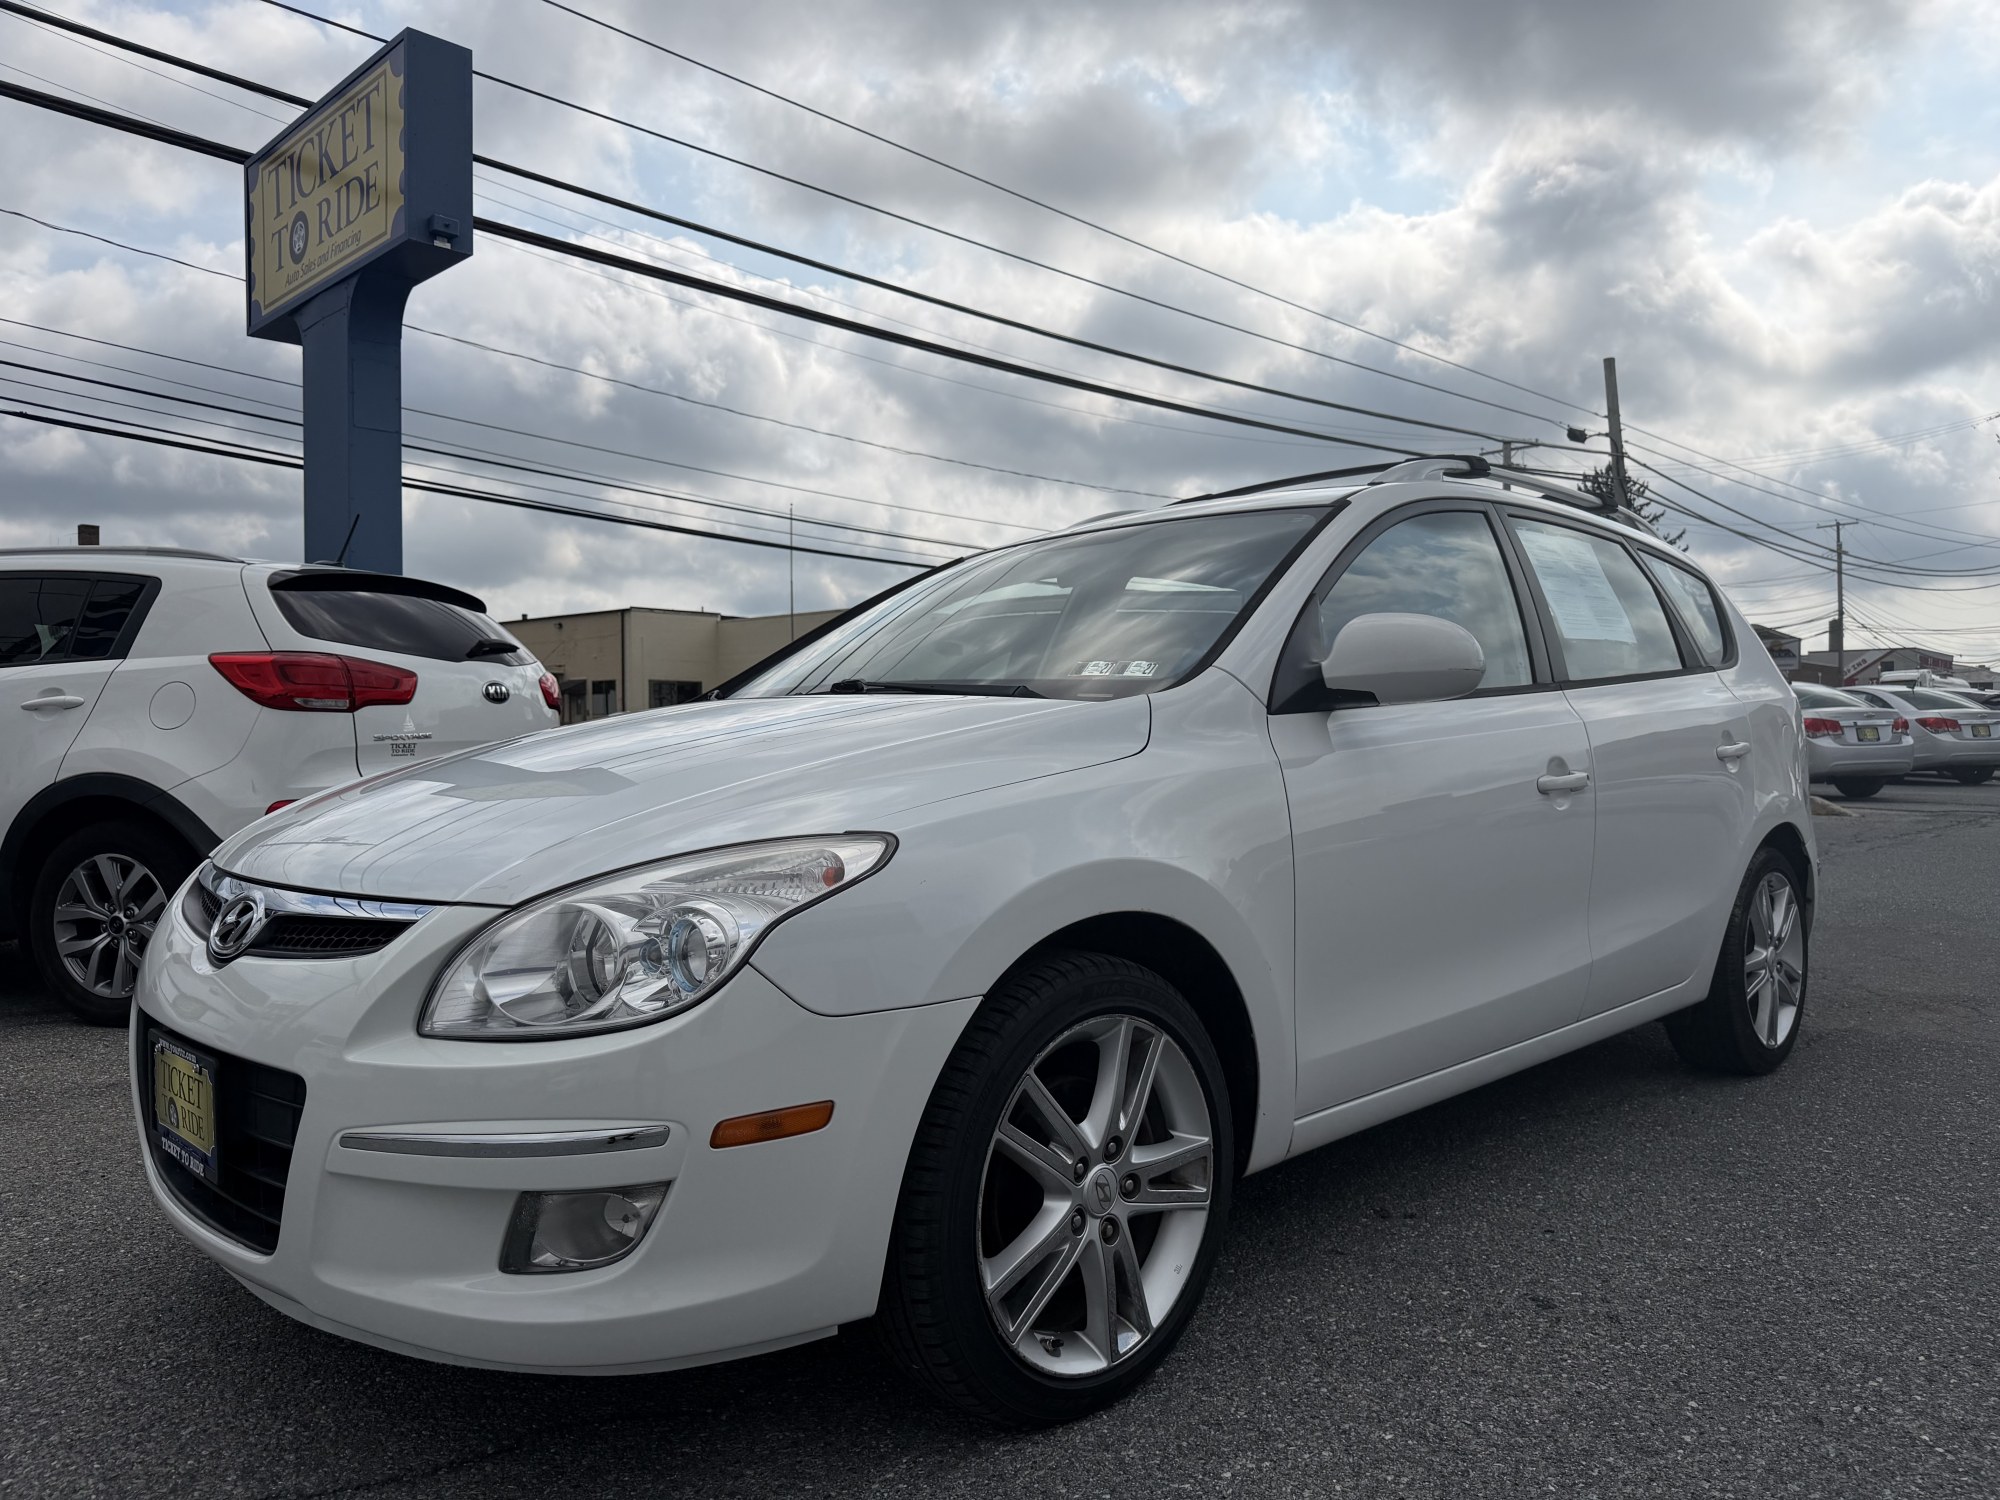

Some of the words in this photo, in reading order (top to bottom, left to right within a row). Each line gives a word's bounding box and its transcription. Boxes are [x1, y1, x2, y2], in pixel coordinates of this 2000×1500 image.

[267, 81, 380, 221] TICKET
[316, 160, 381, 246] RIDE
[285, 266, 300, 288] Auto
[300, 256, 316, 279] Sales
[317, 246, 329, 268] and
[330, 229, 362, 257] Financing
[487, 685, 508, 699] KIA
[373, 732, 432, 742] SPORTAGE
[161, 1058, 204, 1110] TICKET
[180, 1105, 205, 1141] RIDE
[161, 1136, 181, 1160] TICKET
[181, 1150, 189, 1166] TO
[190, 1156, 205, 1177] RIDE
